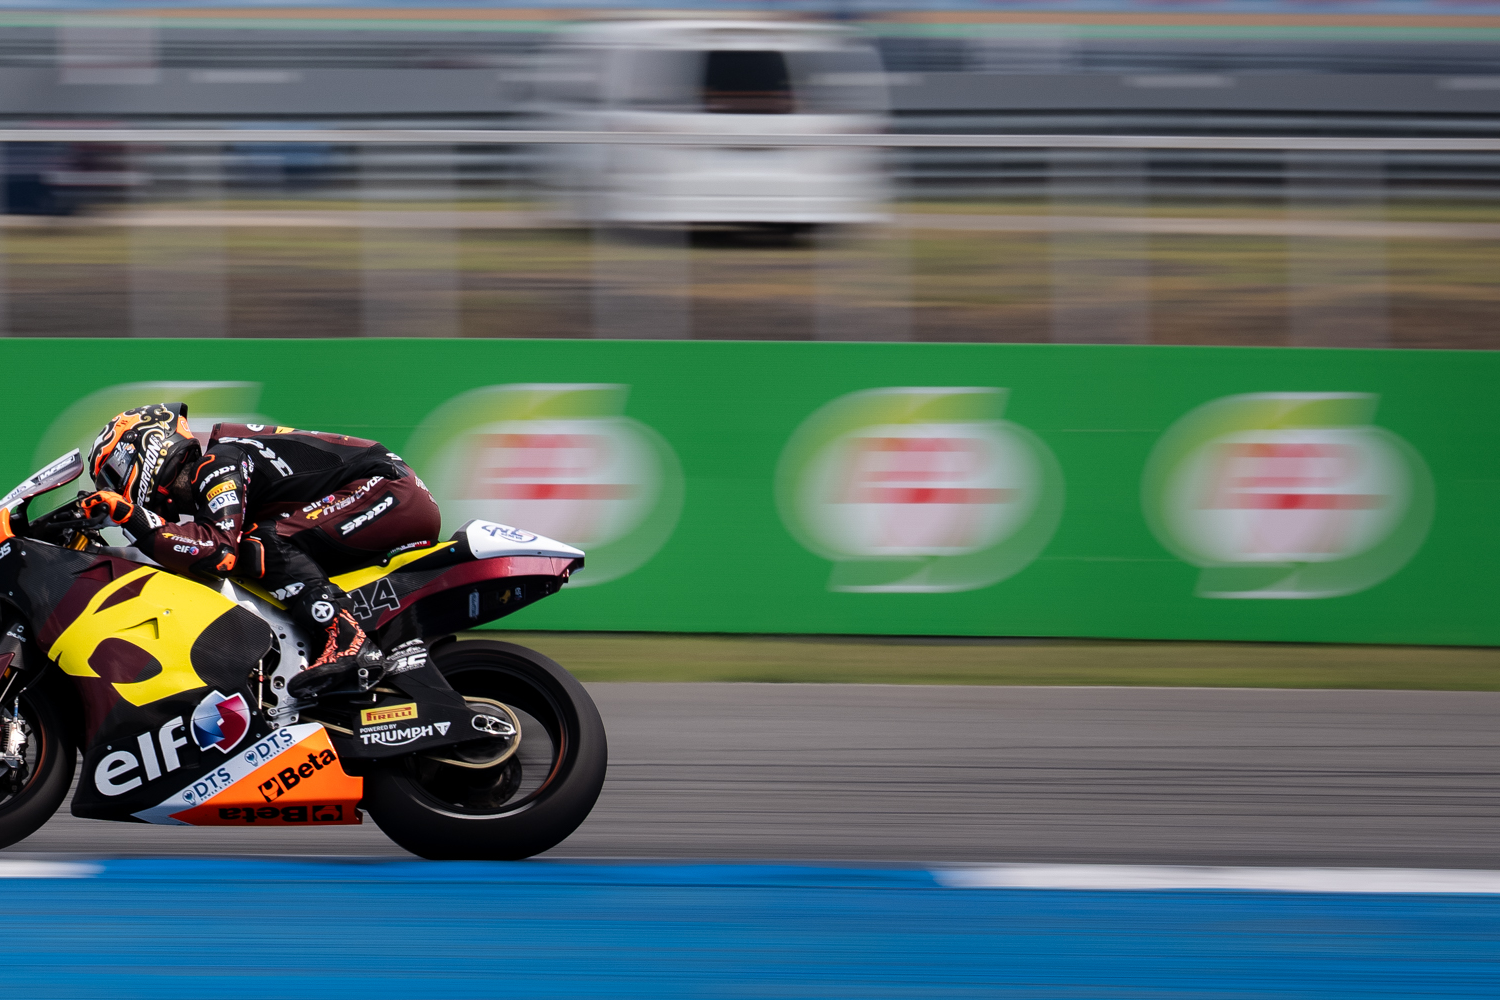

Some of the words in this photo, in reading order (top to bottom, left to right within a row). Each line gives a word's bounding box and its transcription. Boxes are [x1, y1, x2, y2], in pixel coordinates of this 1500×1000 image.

[217, 493, 237, 504] DTS
[341, 496, 393, 535] SPIDI
[366, 706, 412, 721] PIRELLI
[360, 724, 388, 733] POWERED
[360, 725, 434, 745] TRIUMPH
[94, 715, 188, 797] elf
[255, 729, 293, 759] DTS
[277, 748, 337, 790] Beta
[193, 768, 231, 798] DTS
[218, 805, 308, 822] Beta
